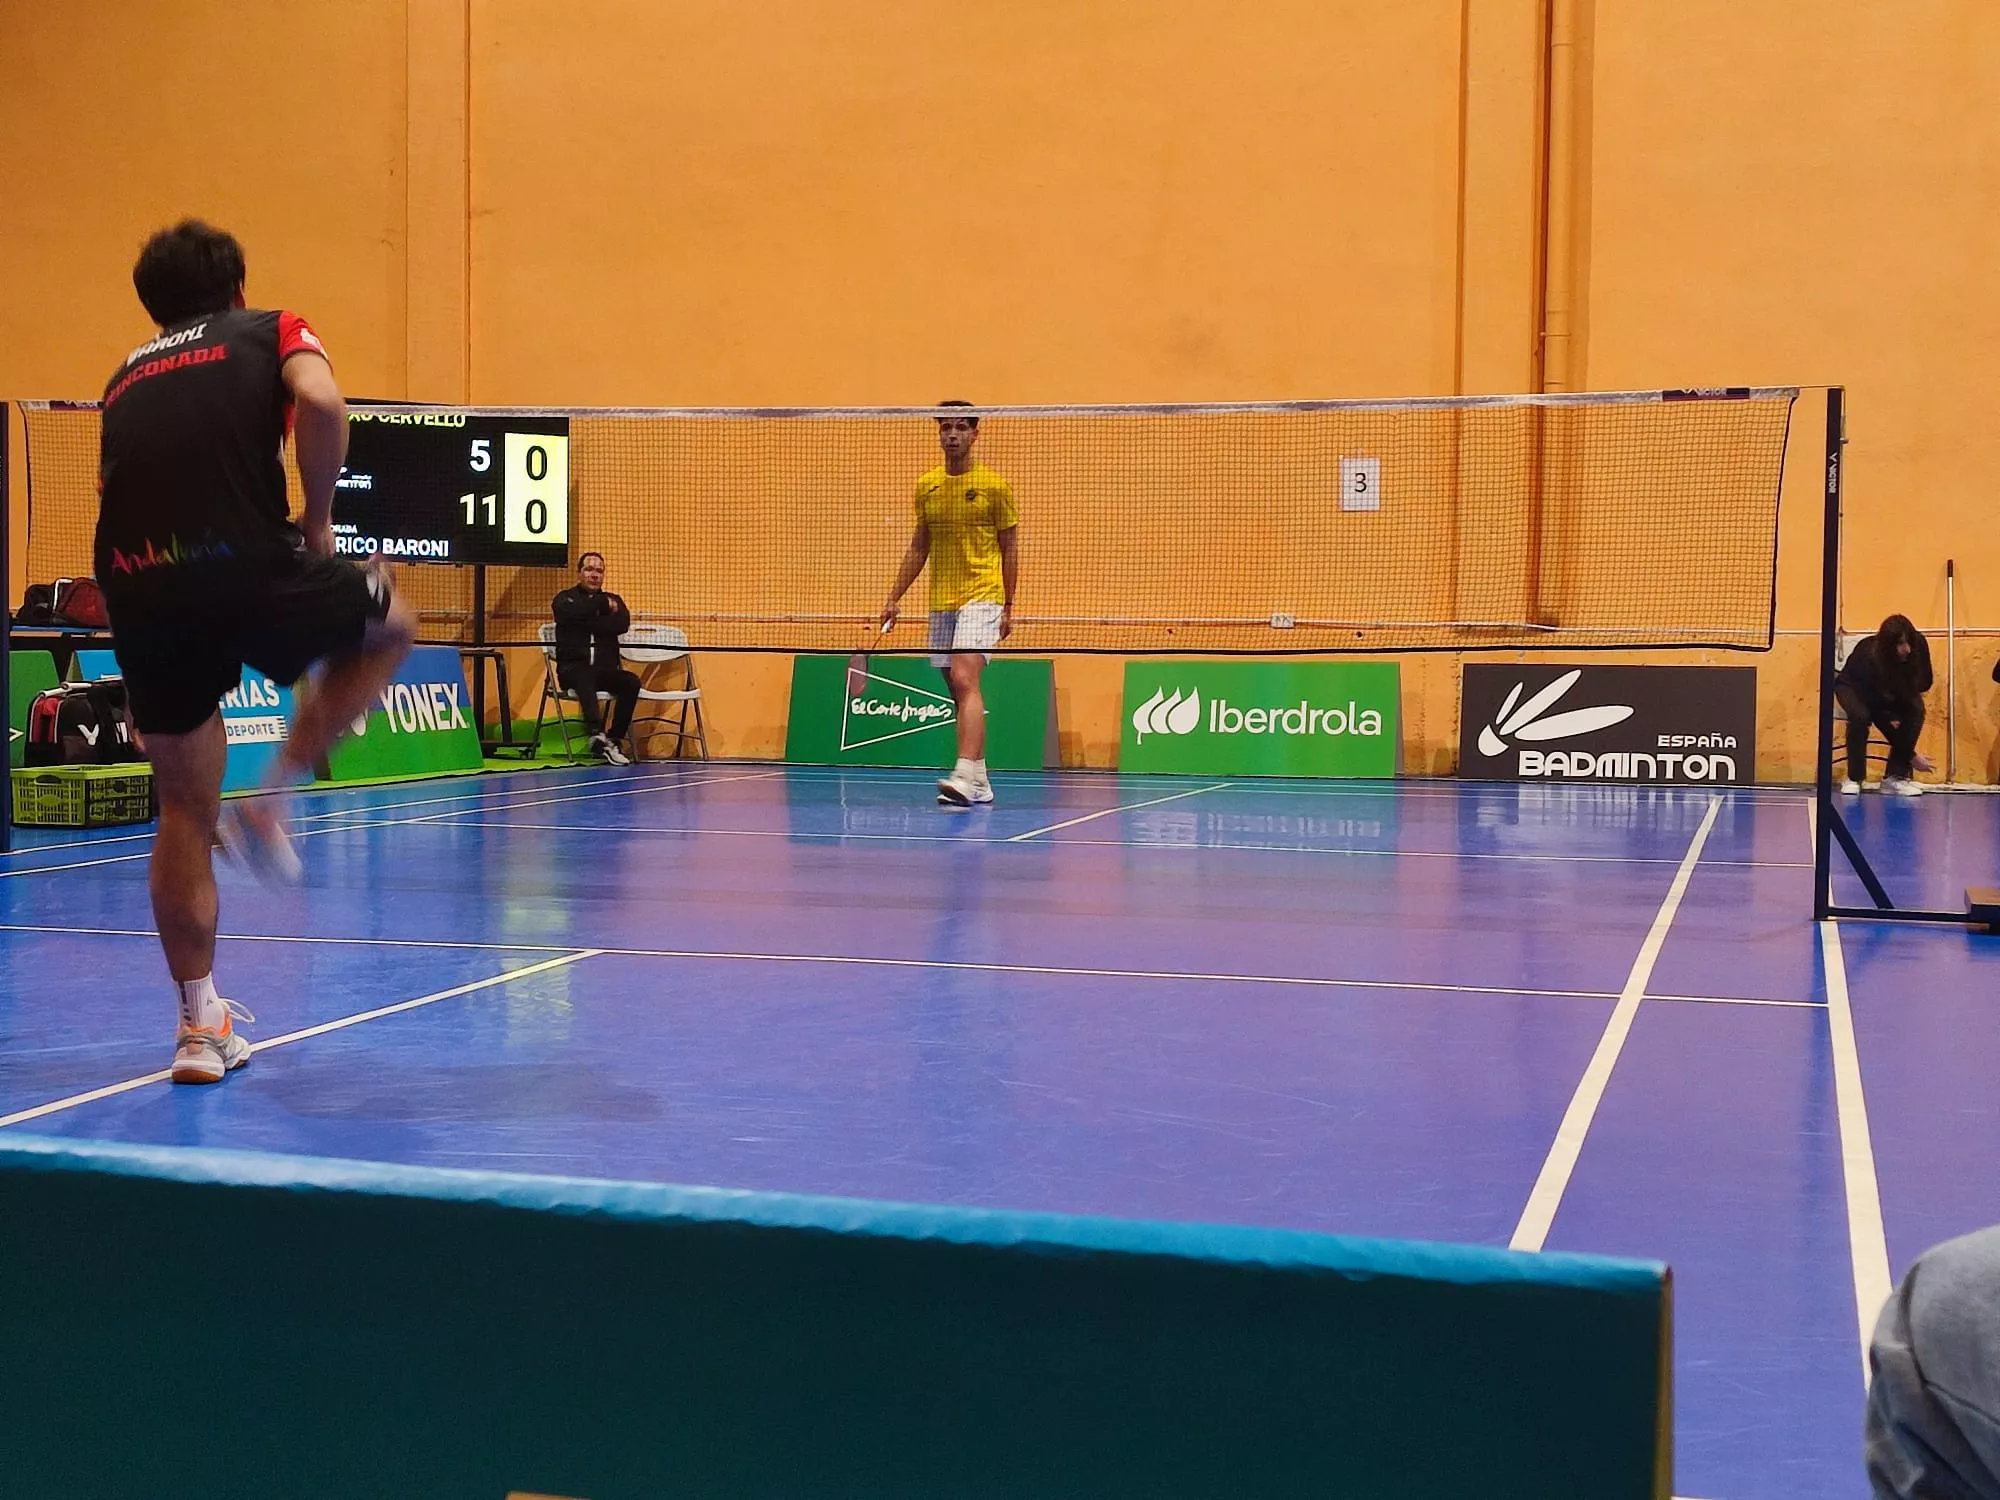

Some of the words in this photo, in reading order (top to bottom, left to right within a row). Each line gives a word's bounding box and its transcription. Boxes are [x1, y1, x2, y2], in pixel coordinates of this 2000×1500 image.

[469, 439, 492, 472] 5
[526, 445, 548, 481] 0
[1354, 472, 1367, 493] 3
[459, 492, 497, 526] 11
[525, 499, 547, 534] 0
[335, 536, 378, 555] RICO
[382, 538, 449, 557] BARONI
[380, 682, 469, 734] YONEX
[850, 698, 866, 715] El
[866, 699, 901, 716] Corte
[901, 696, 952, 722] Inglés
[1209, 699, 1382, 736] Iberdrola
[226, 723, 276, 737] DEPORTE
[1518, 750, 1736, 780] BADMINTON
